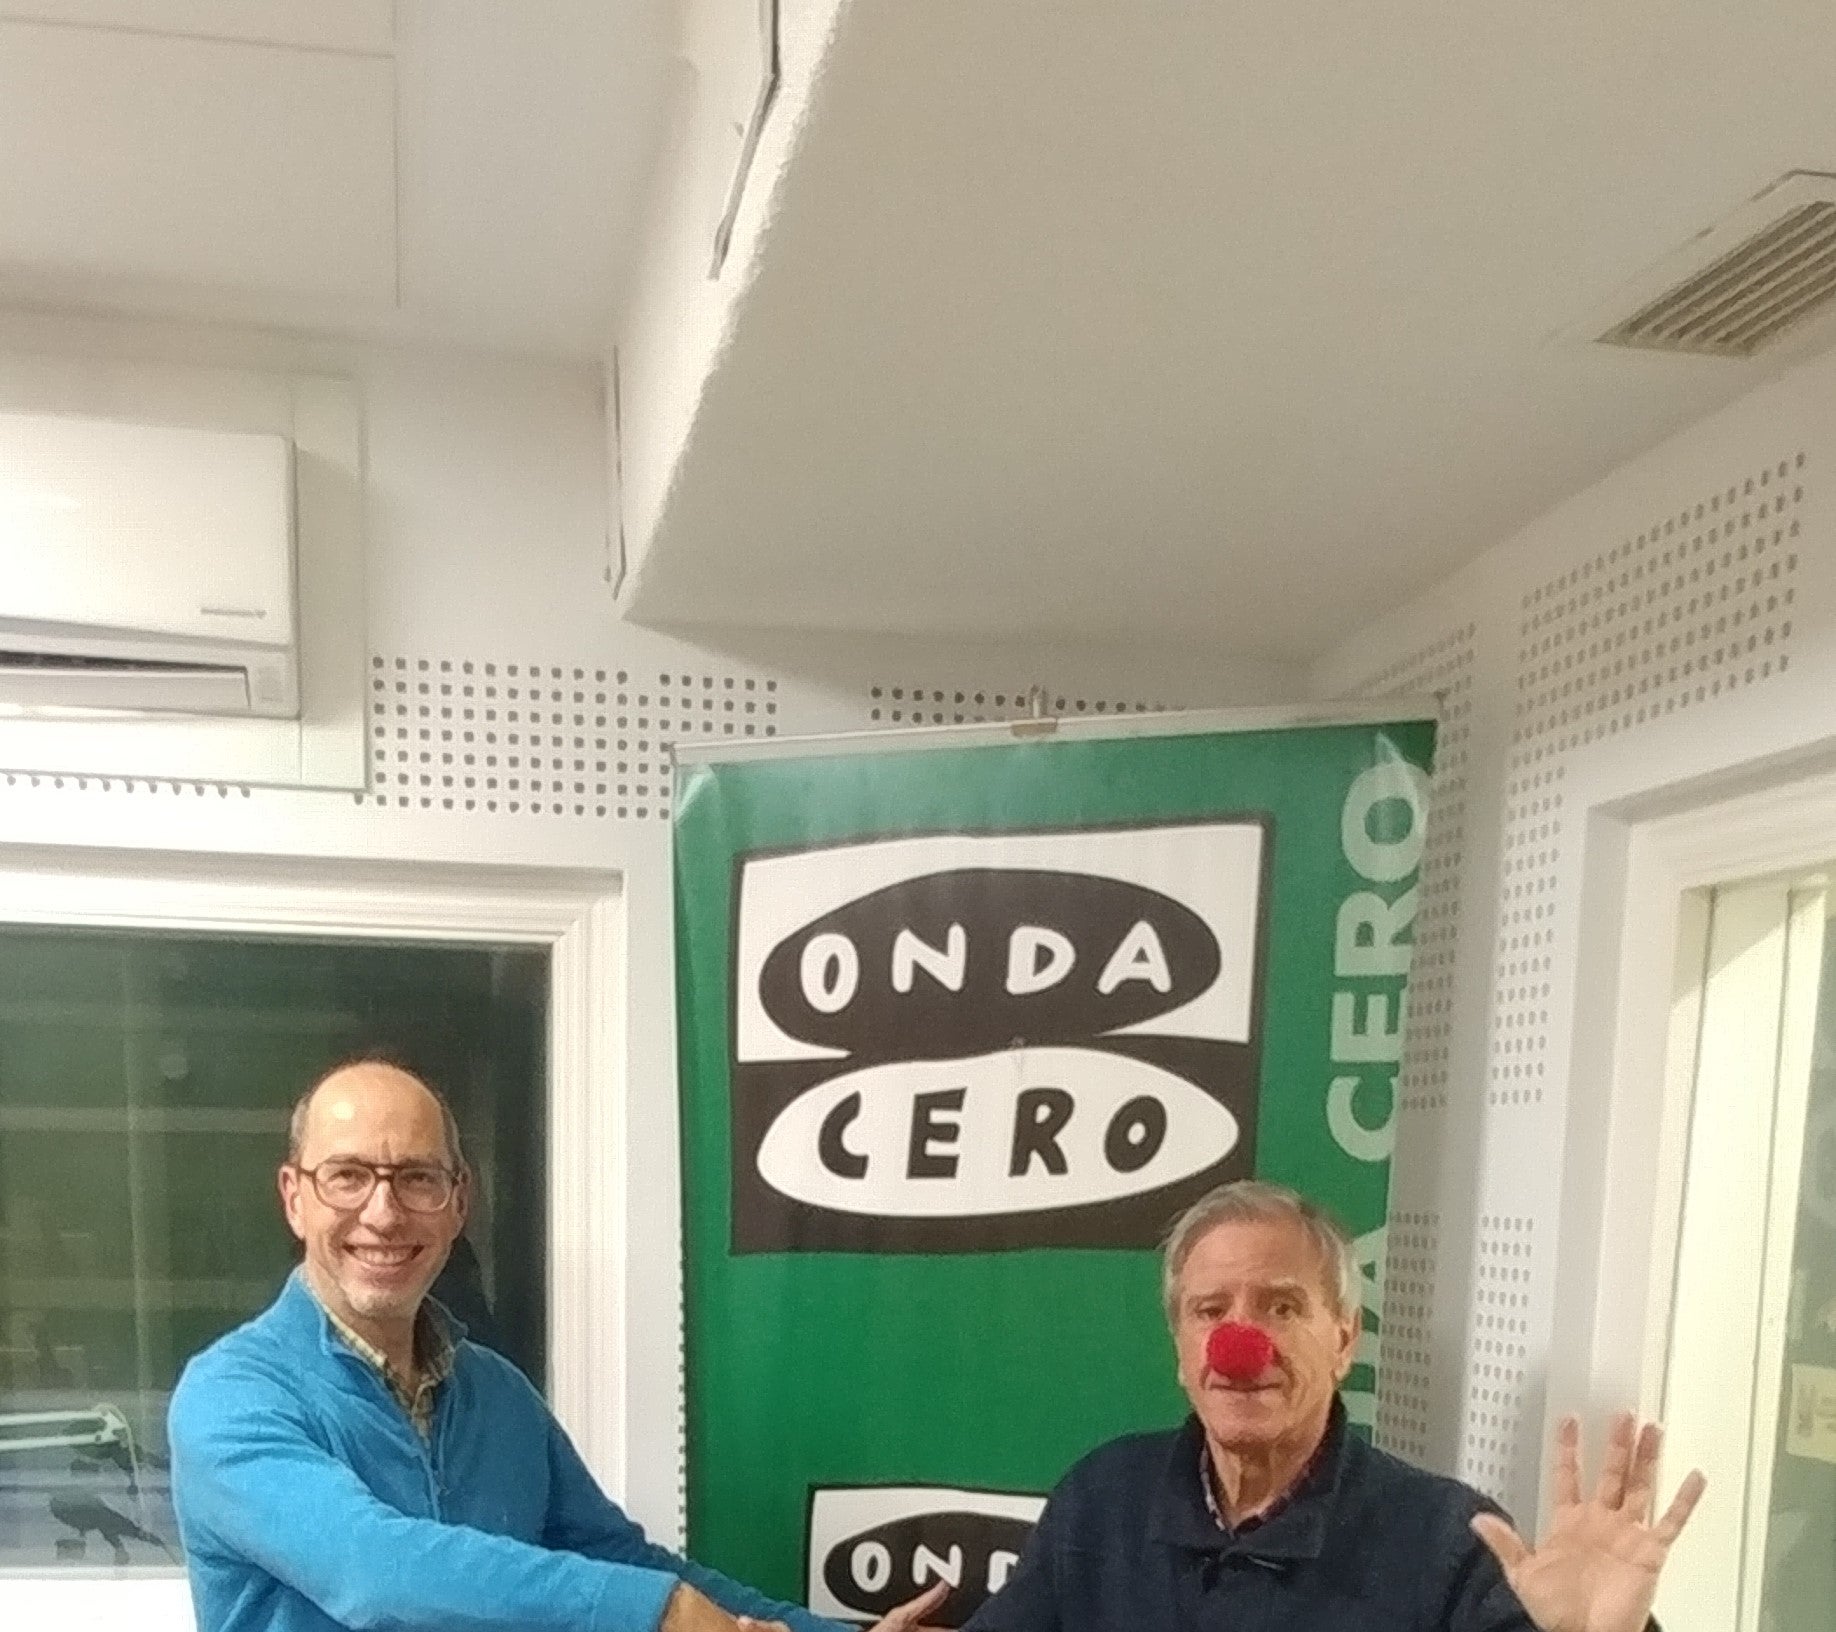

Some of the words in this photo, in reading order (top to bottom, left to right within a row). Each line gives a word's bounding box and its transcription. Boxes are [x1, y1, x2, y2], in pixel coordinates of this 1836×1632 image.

[800, 919, 1172, 1013] ONDA
[1326, 761, 1431, 1162] CERO
[817, 1086, 1168, 1180] CERO
[851, 1541, 1019, 1594] ON
